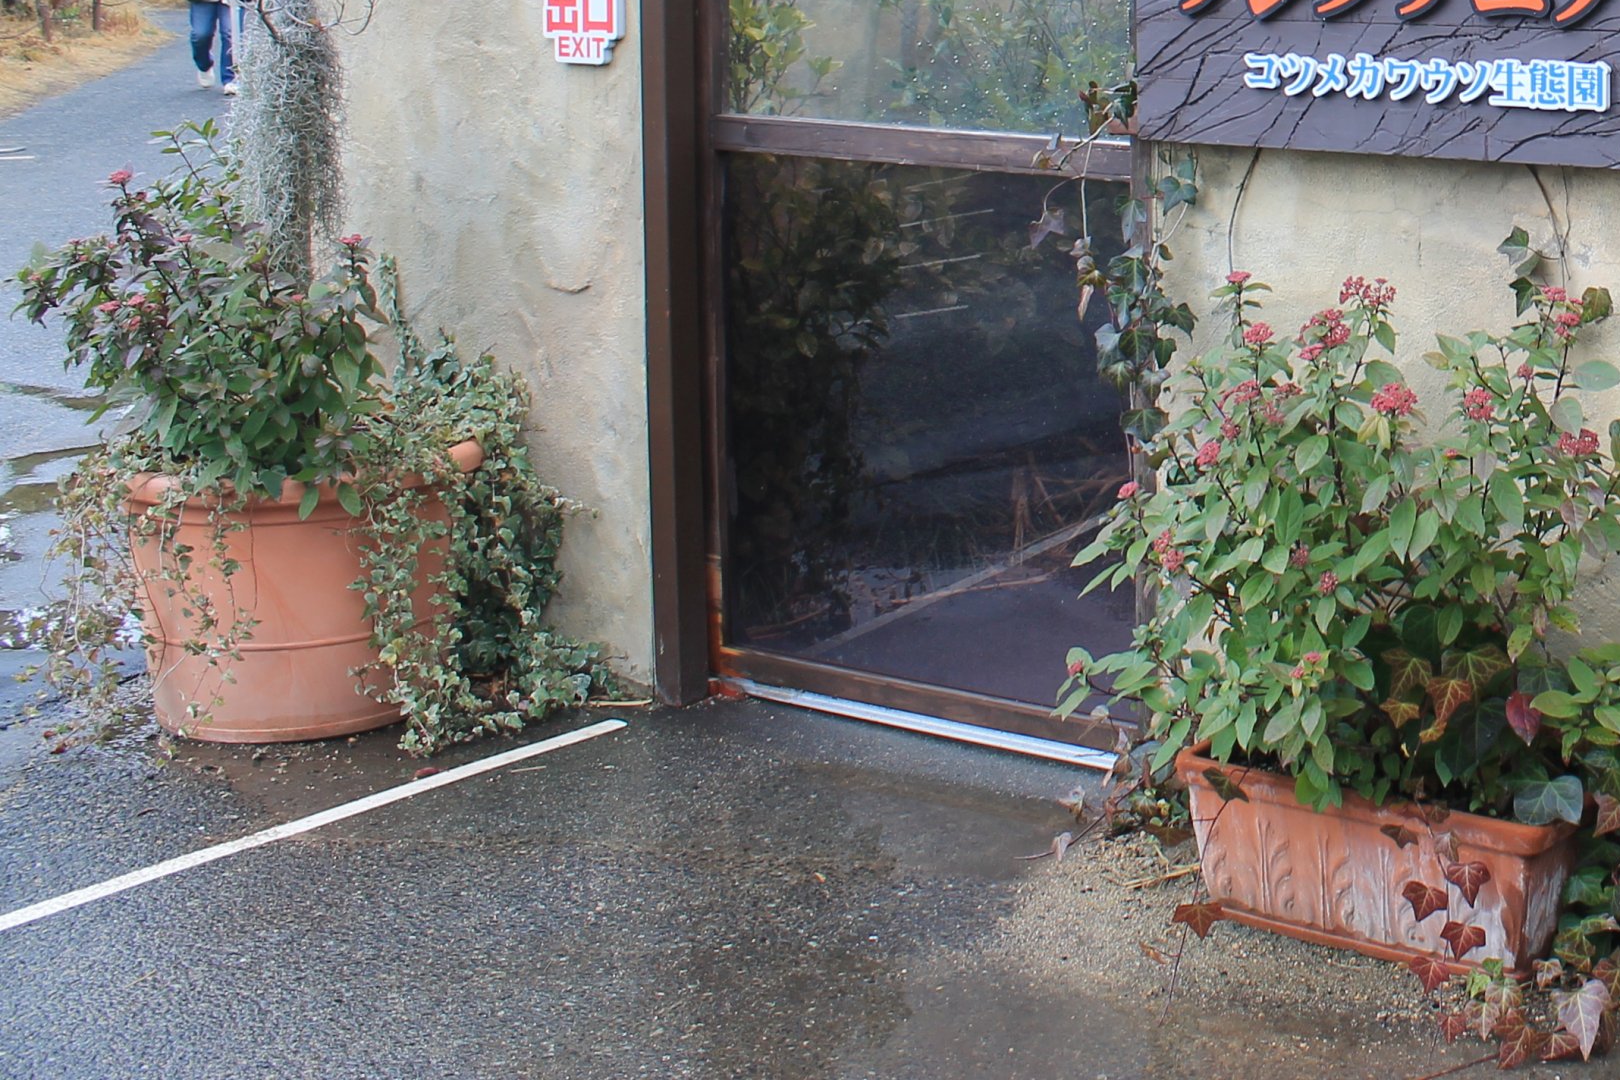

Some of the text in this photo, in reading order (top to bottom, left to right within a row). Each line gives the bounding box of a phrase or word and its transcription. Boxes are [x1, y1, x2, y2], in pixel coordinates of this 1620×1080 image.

[559, 36, 605, 58] EXIT
[1247, 54, 1606, 110] コツメカワウソ生態園
